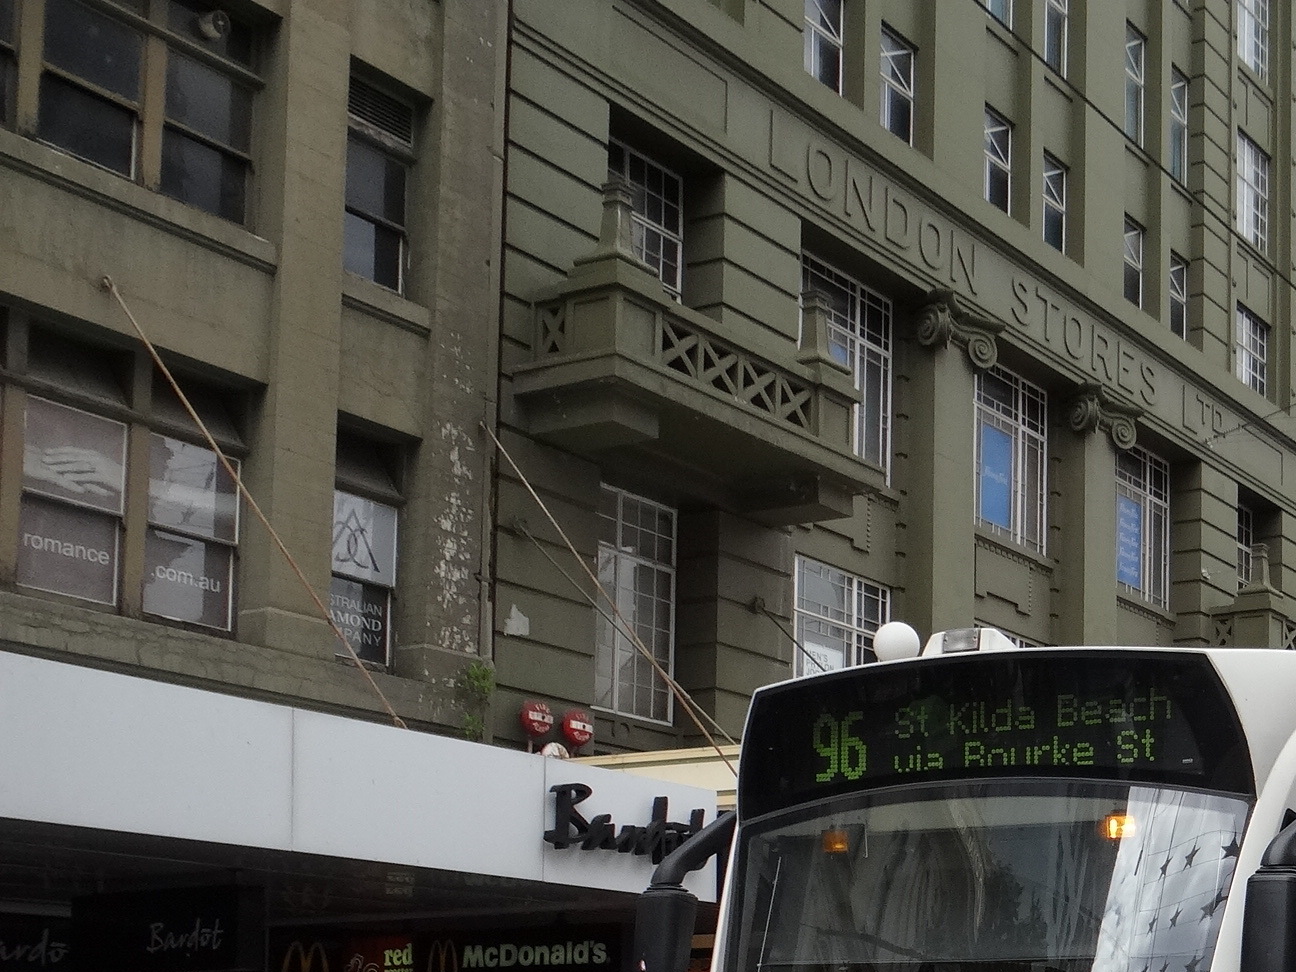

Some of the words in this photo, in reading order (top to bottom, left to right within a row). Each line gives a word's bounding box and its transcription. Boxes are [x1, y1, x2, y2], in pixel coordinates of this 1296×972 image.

[767, 109, 978, 296] LONDON
[1010, 276, 1158, 408] STORES
[23, 532, 110, 566] romance
[150, 564, 221, 593] .com.au
[330, 593, 382, 617] STRALIAN
[342, 627, 381, 646] PANY
[894, 705, 930, 739] St
[946, 699, 1036, 735] Kilda
[1056, 688, 1173, 728] Beach
[812, 711, 867, 783] 96
[1116, 728, 1156, 765] St
[146, 917, 225, 954] Bardot
[384, 942, 414, 967] red
[461, 940, 608, 969] McDonald's
